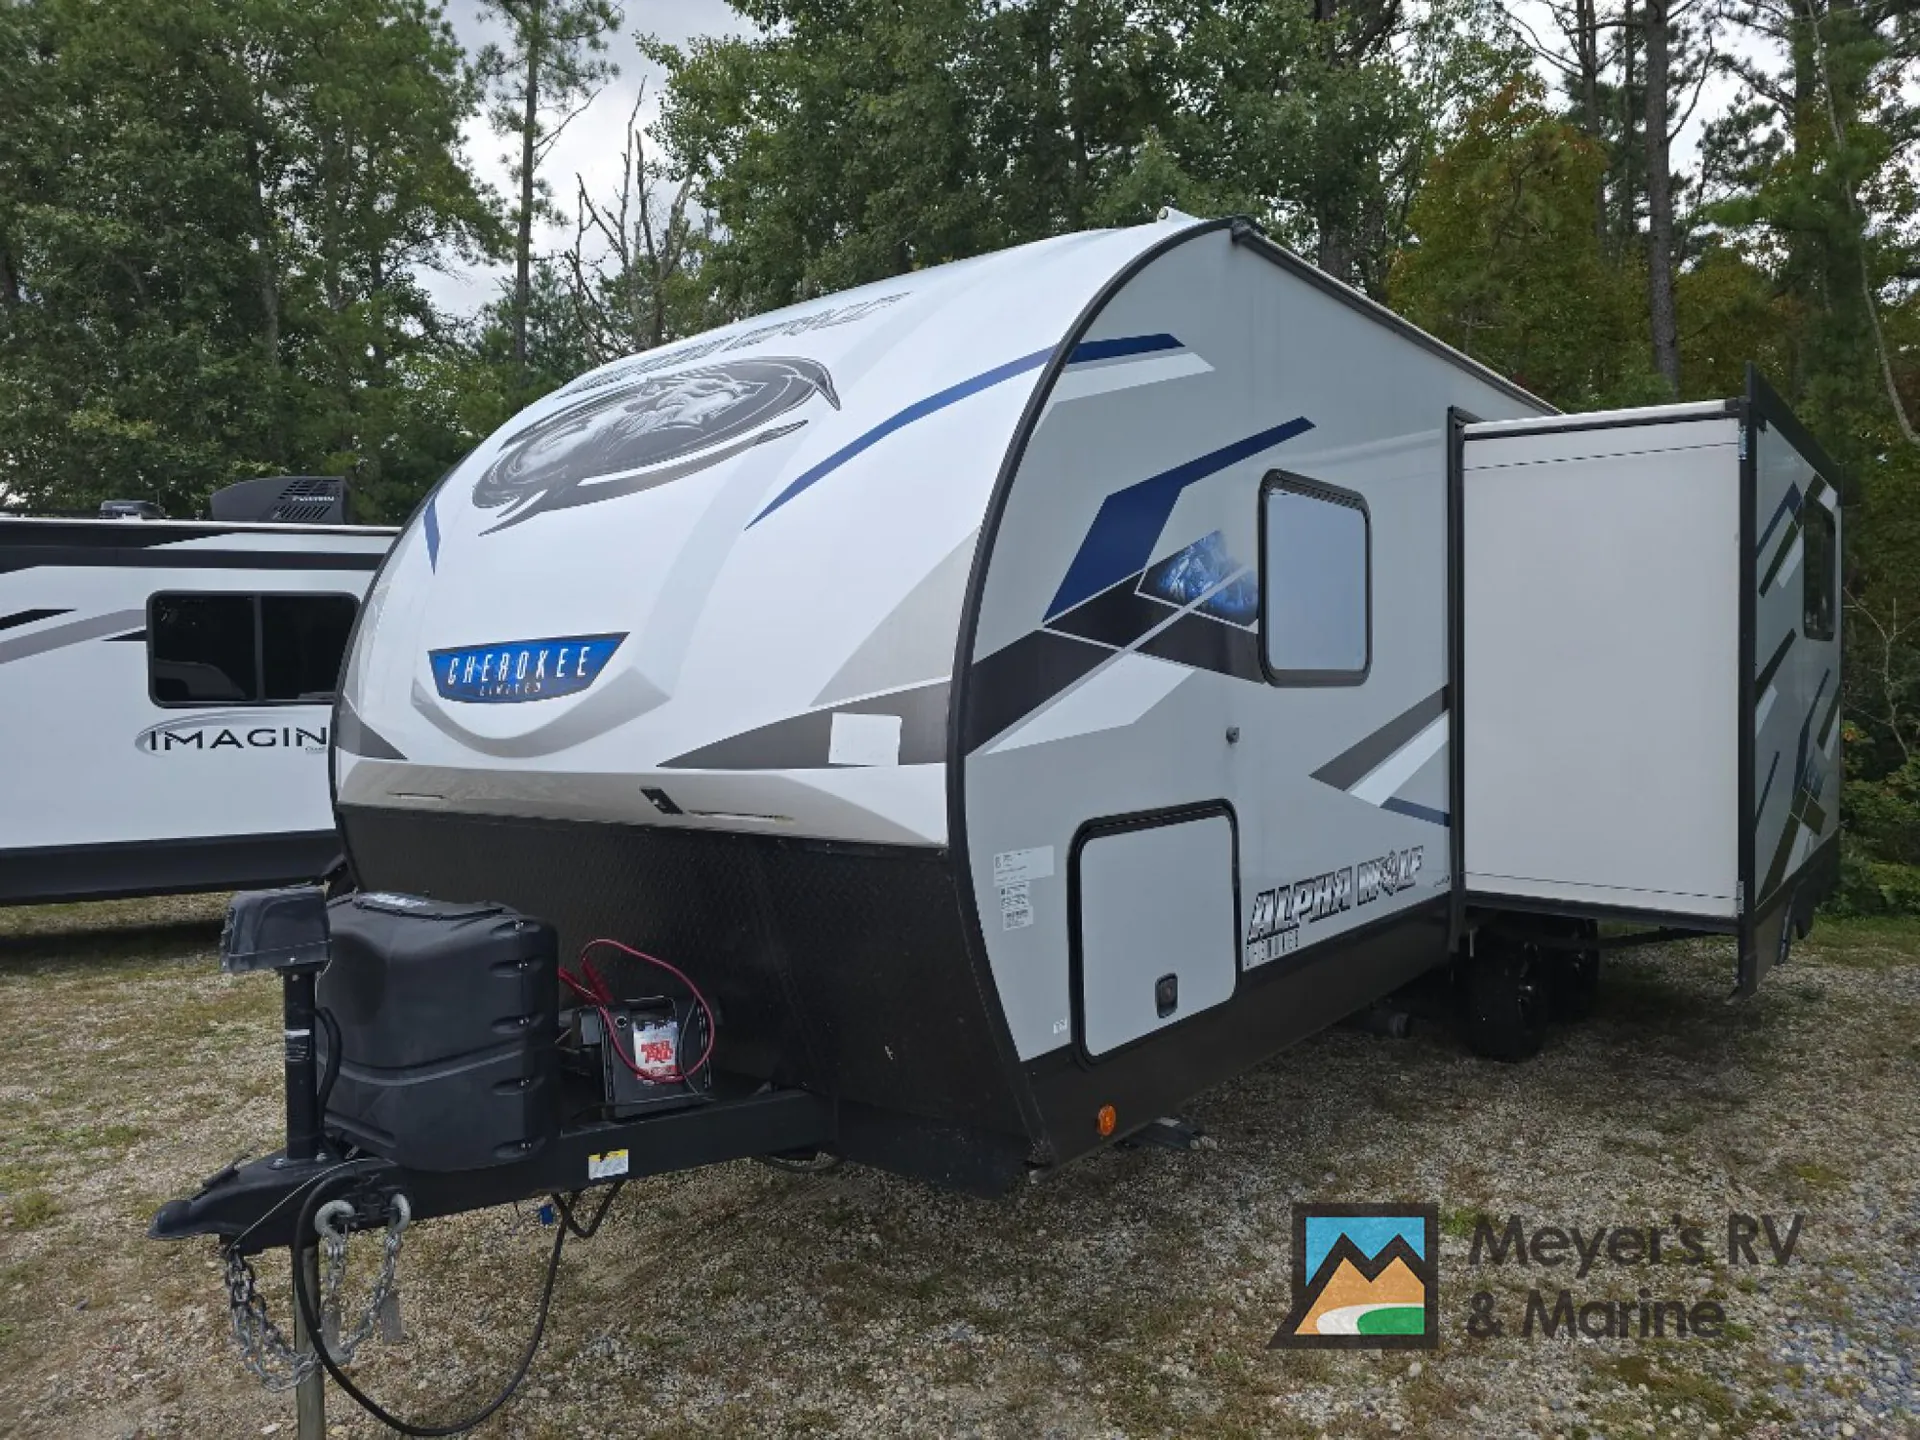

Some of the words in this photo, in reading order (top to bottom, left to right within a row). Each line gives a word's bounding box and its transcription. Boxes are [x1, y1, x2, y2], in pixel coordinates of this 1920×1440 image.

[447, 646, 592, 686] CHEROKEE
[150, 726, 328, 751] IMAGIN
[1246, 866, 1353, 945] ALPHA
